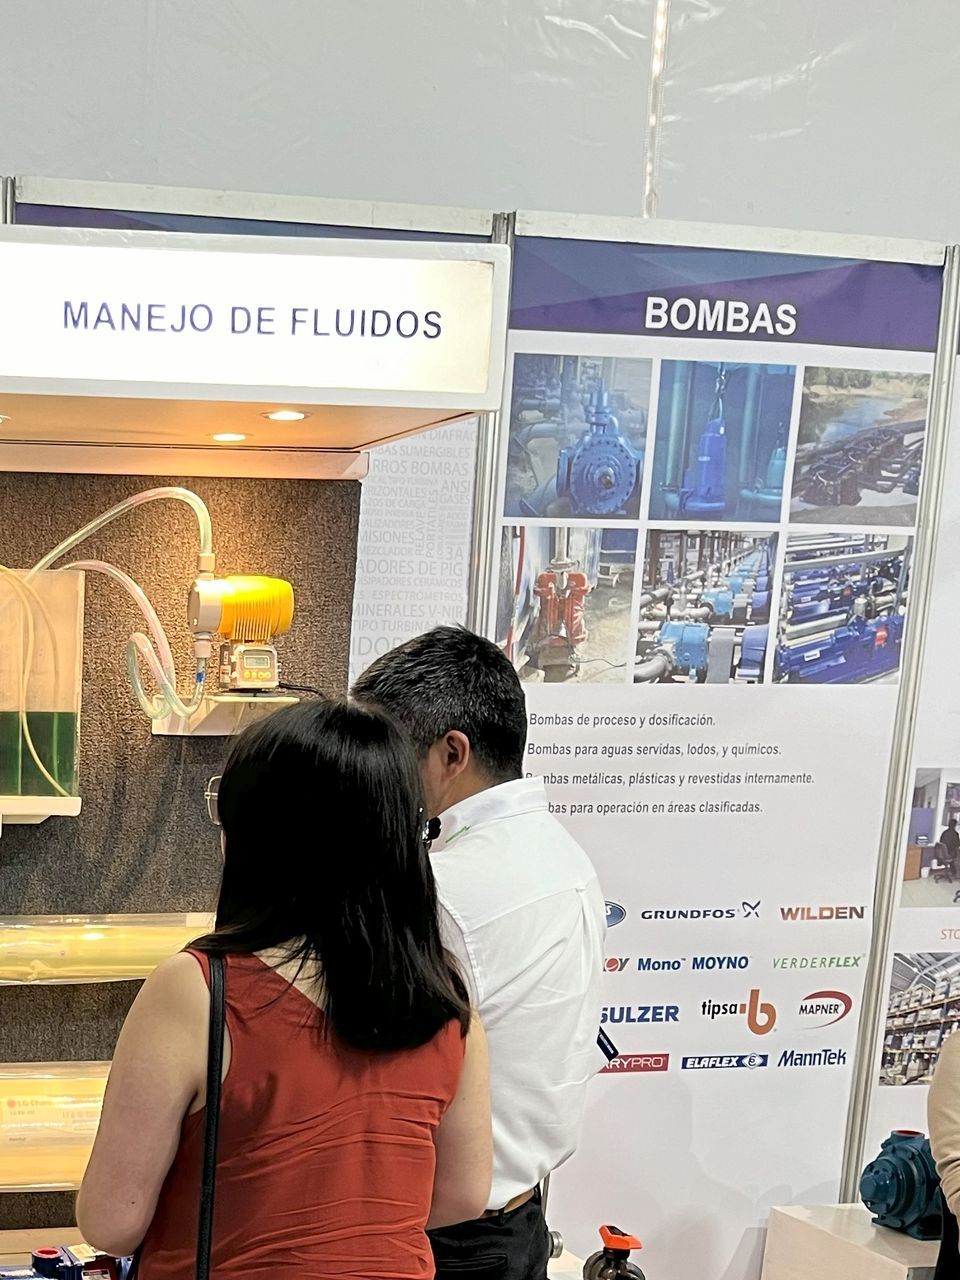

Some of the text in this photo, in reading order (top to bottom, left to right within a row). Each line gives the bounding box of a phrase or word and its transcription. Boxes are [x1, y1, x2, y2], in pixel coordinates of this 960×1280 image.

[63, 301, 442, 339] MANEJO DE FLUIDOS
[645, 296, 797, 336] BOMBAS
[411, 460, 469, 477] BOMBAS
[418, 561, 438, 576] DE
[530, 713, 716, 728] Bombas de proceso y dosificación.
[527, 743, 782, 758] Bombas para aguas servidas, lodos, y químicos.
[572, 772, 626, 786] metálicas,
[629, 772, 676, 787] plásticas
[679, 774, 686, 787] y
[688, 772, 742, 785] revestidas
[745, 771, 815, 785] internamente.
[570, 804, 594, 816] para
[597, 801, 649, 815] operación
[652, 803, 665, 814] en
[668, 801, 696, 814] áreas
[699, 801, 764, 814] clasificadas.
[641, 909, 736, 920] GRUNDFOS
[780, 906, 865, 921] WILDEN
[638, 957, 681, 971] Mono
[692, 956, 749, 970] MOYNO
[772, 956, 862, 969] VERDERFLEX
[701, 1000, 738, 1020] tipsa
[798, 1004, 840, 1015] MAPNER
[685, 1056, 740, 1069] ELAFLEX
[777, 1049, 848, 1067] MannTek
